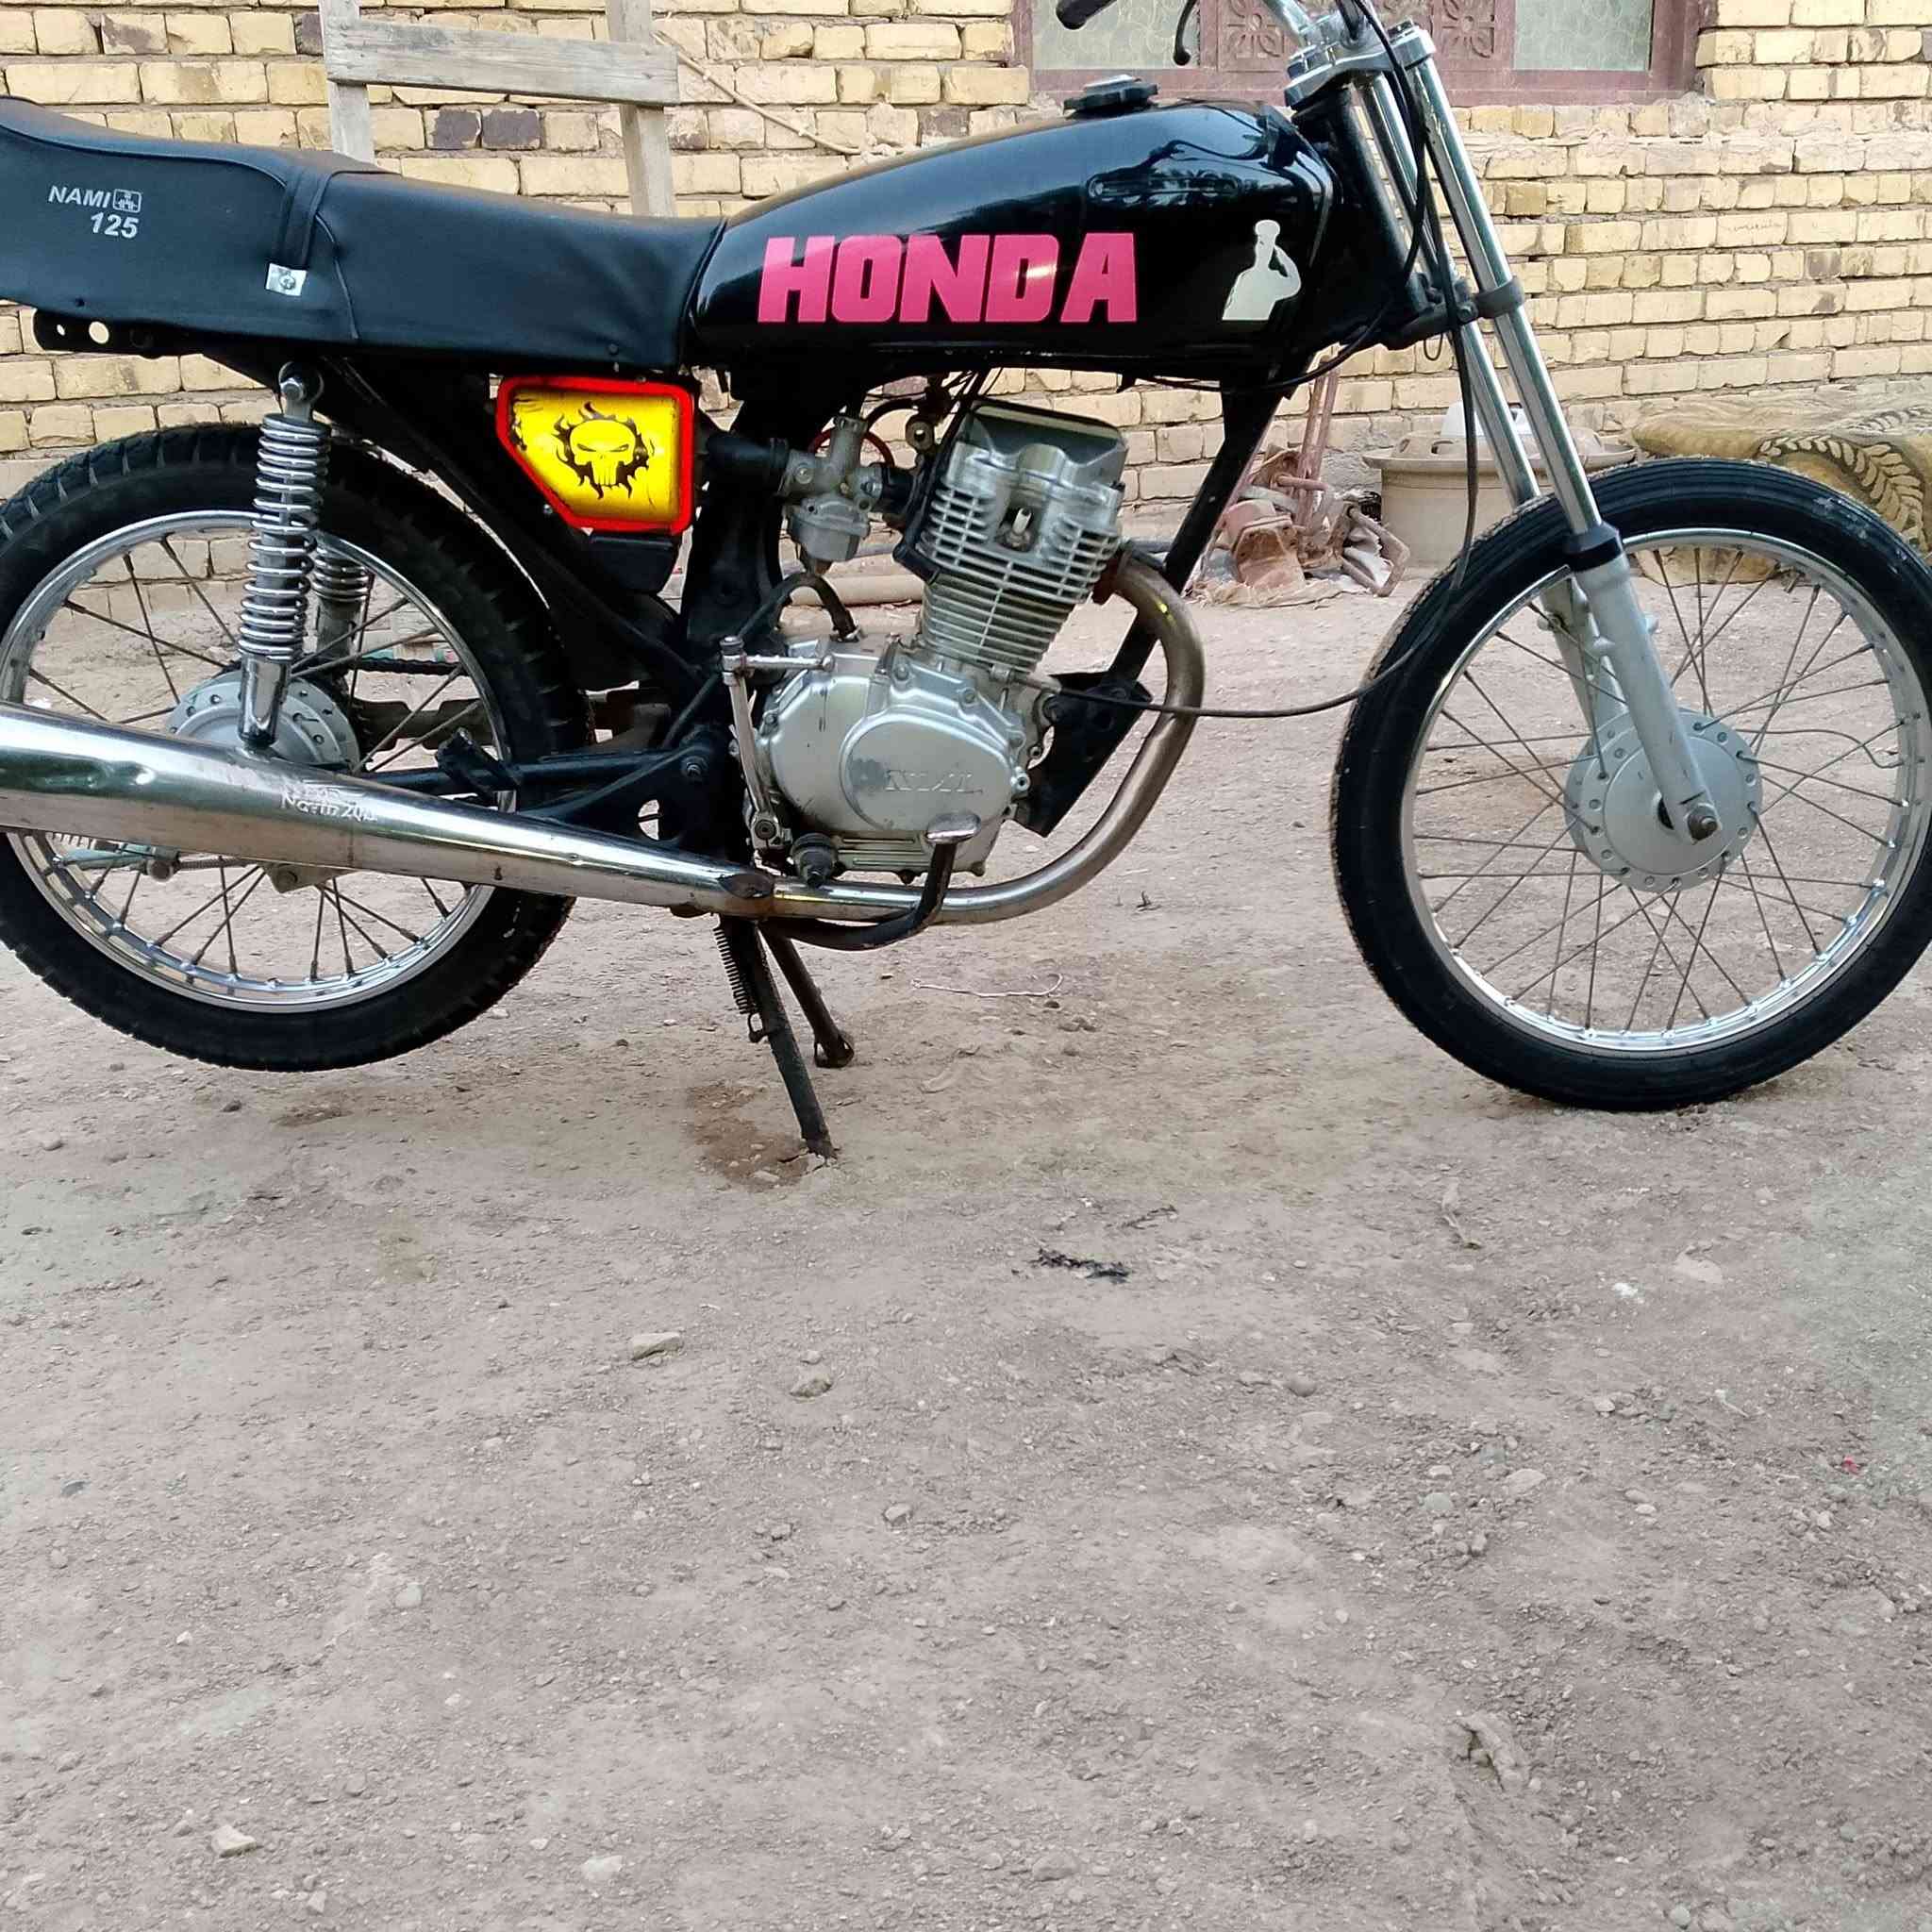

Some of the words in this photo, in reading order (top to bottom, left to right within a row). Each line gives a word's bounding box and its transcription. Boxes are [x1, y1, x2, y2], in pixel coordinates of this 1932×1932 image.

[48, 186, 111, 208] NAMI
[91, 212, 140, 239] 125
[758, 233, 1138, 323] HONDA
